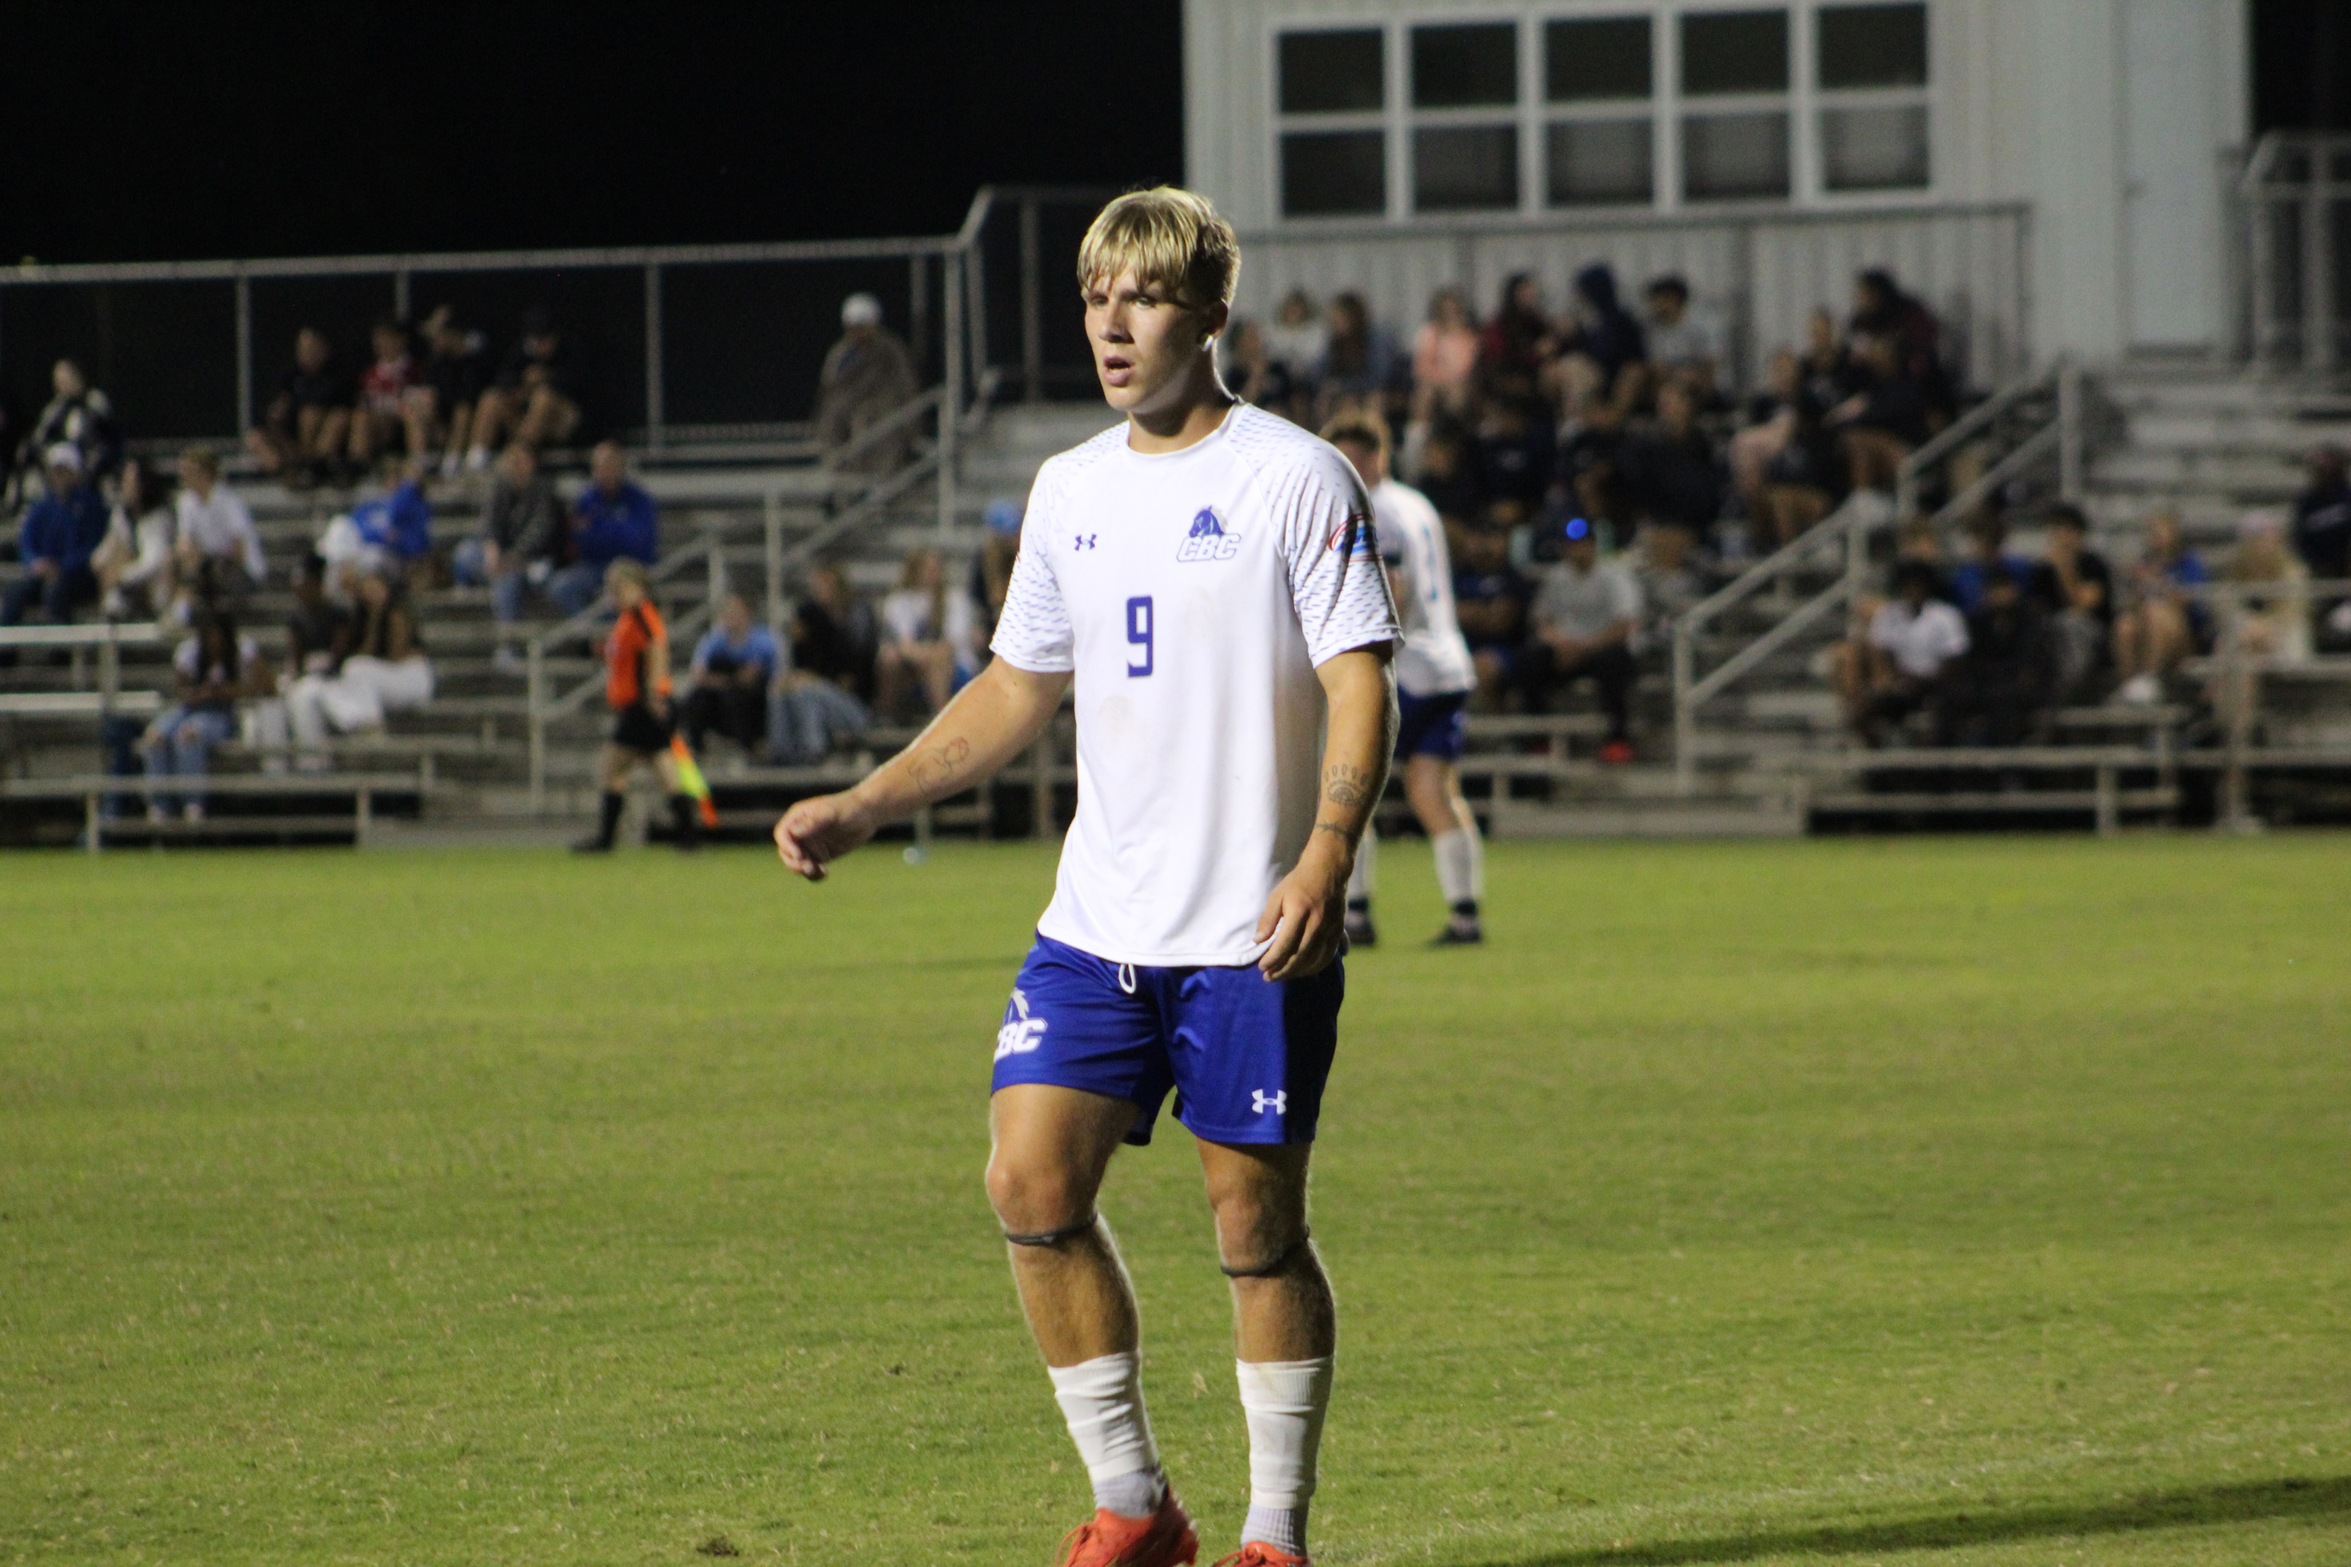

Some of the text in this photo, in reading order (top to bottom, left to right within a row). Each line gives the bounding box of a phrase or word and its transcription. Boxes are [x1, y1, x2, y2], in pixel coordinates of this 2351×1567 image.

[1176, 532, 1242, 563] CBC
[1126, 595, 1154, 678] 9
[993, 1016, 1048, 1064] BC
